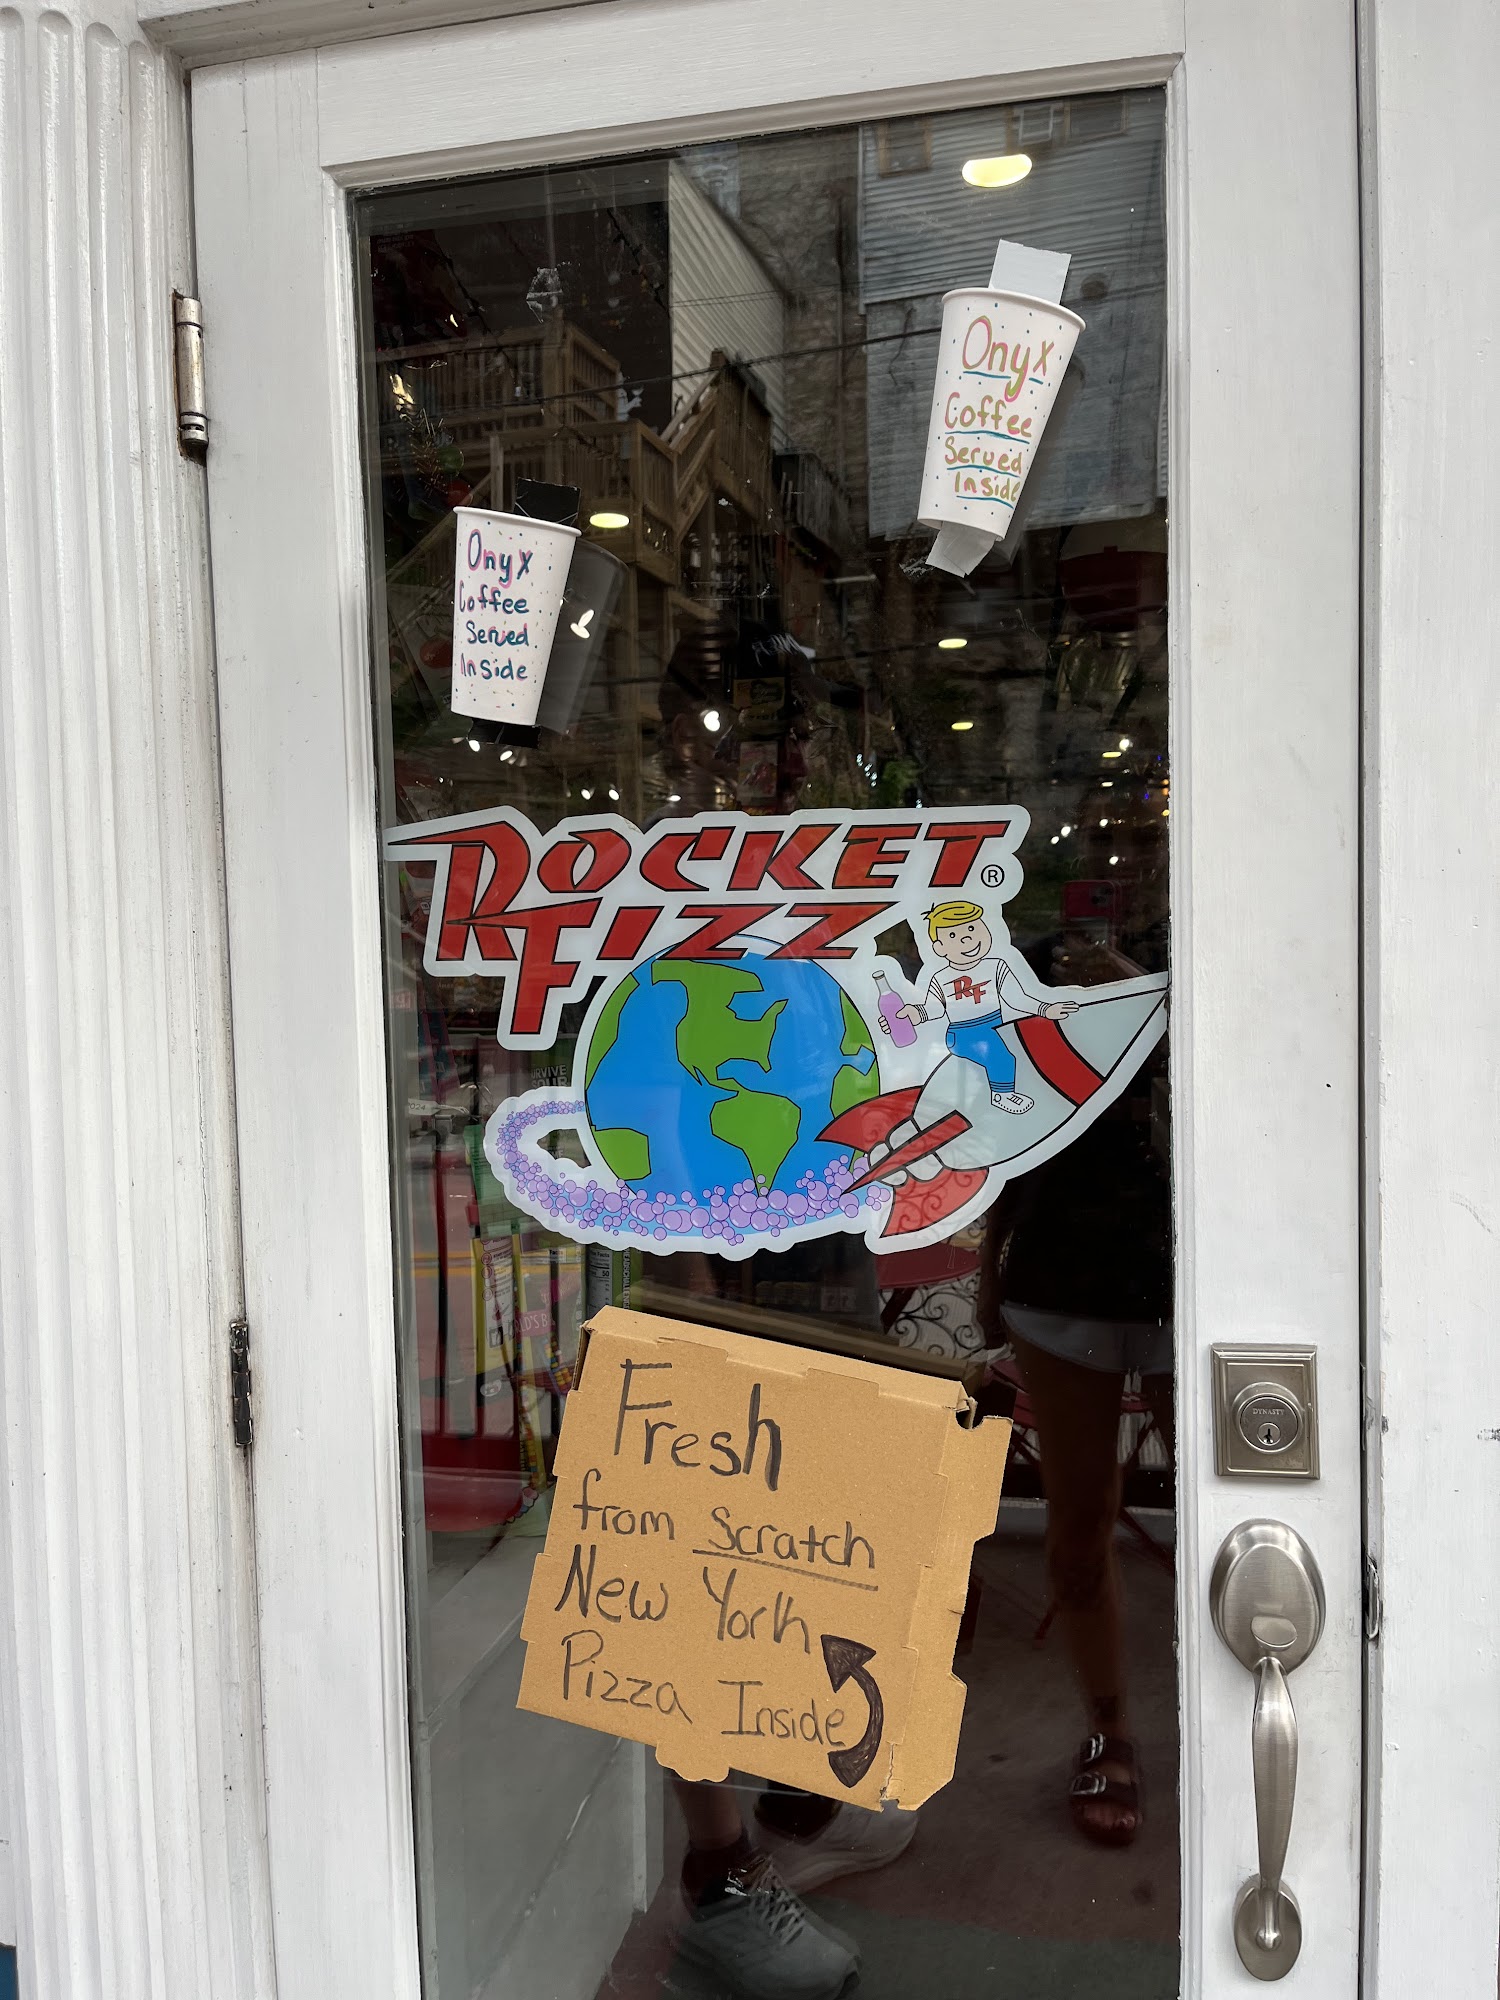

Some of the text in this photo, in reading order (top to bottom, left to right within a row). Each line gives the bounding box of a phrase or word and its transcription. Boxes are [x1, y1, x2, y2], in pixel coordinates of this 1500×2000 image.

[962, 315, 1055, 402] Onyx
[944, 391, 1032, 438] Coffee
[944, 435, 1022, 474] Served
[954, 471, 1021, 502] Inside
[467, 529, 533, 588] Onyx
[459, 580, 529, 614] Coffee
[466, 620, 529, 647] Served
[460, 653, 528, 681] Inside
[388, 820, 1009, 961] ROCKET
[447, 898, 902, 1035] FIZZ
[614, 1358, 782, 1492] Fresh
[1252, 1407, 1285, 1416] DYNASTY
[573, 1468, 876, 1569] from Scratch
[555, 1544, 811, 1654] New York
[561, 1630, 846, 1747] Pizza Inside
